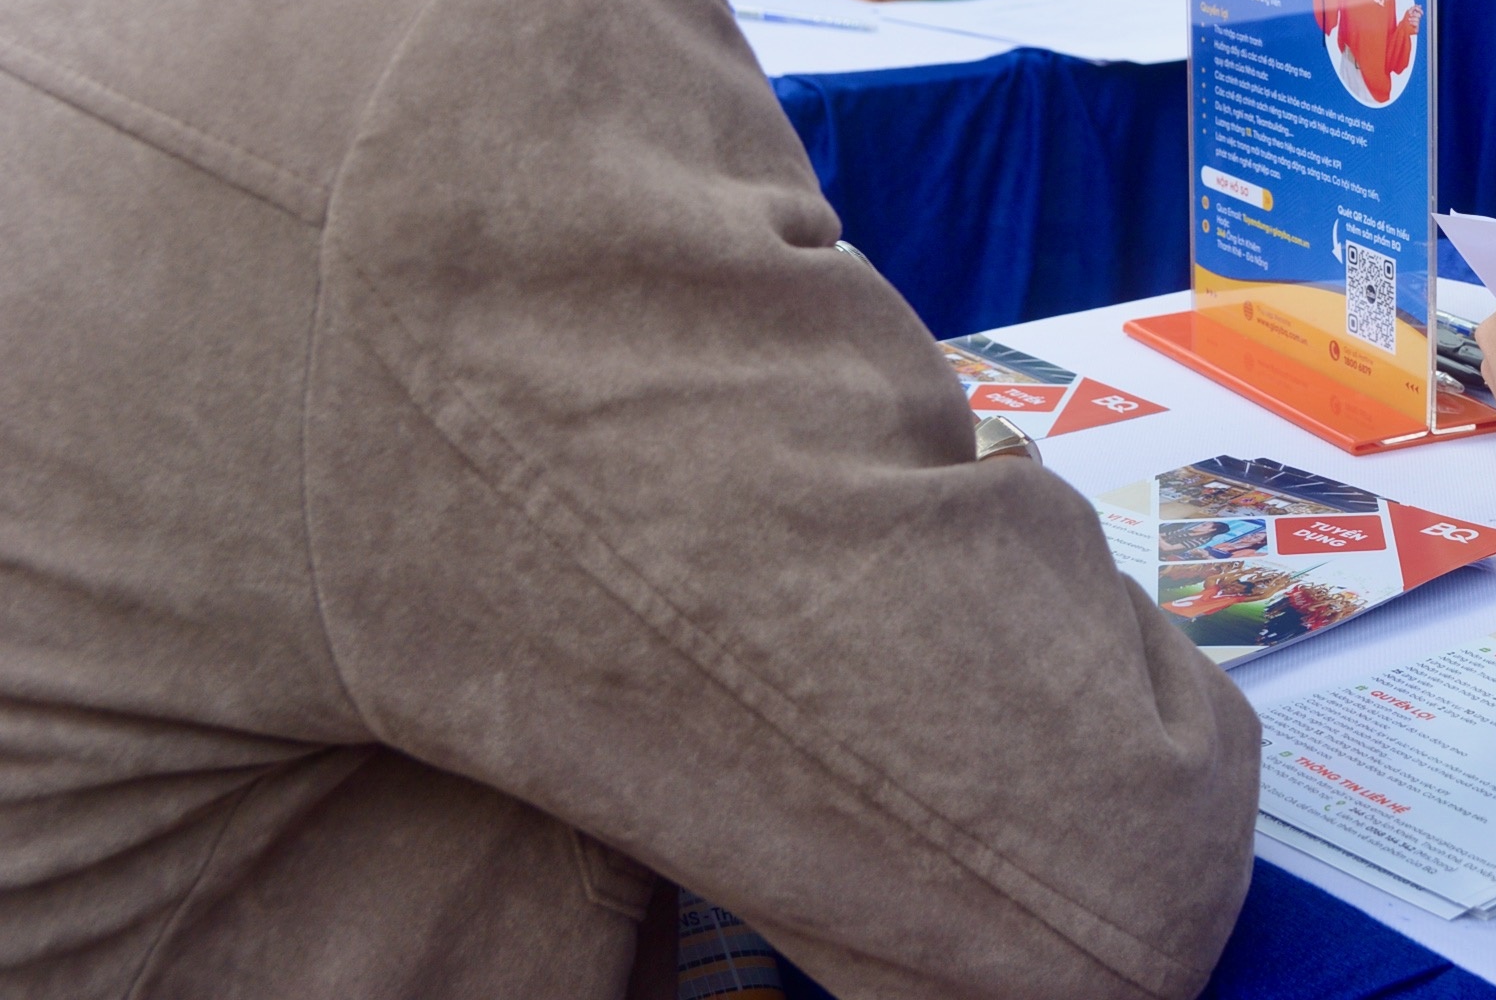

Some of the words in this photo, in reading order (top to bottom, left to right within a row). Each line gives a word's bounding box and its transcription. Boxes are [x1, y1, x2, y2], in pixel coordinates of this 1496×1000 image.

[1216, 174, 1228, 190] NỘP
[1216, 201, 1226, 214] Qua
[1336, 203, 1352, 219] Quét
[1352, 209, 1362, 223] QR
[1362, 214, 1376, 228] Zalo
[1376, 217, 1384, 231] để
[1386, 223, 1395, 235] tìm
[1396, 225, 1410, 241] hiểu
[1346, 222, 1360, 236] thêm
[1362, 227, 1372, 240] sản
[1373, 231, 1390, 249] phẩm
[1391, 239, 1402, 252] BQ
[1091, 395, 1139, 414] BQ
[1120, 516, 1143, 526] TRÍ
[1292, 529, 1347, 547] DỤNG
[1310, 521, 1369, 542] TUYỂN
[1420, 522, 1480, 544] BQ
[1461, 665, 1477, 674] viên
[1370, 690, 1415, 711] QUYỀN
[1410, 708, 1436, 720] LỢI
[1295, 756, 1342, 781] THÔNG
[1339, 778, 1364, 792] TIN
[1359, 789, 1389, 805] LIÊN
[1387, 801, 1411, 814] HỆ
